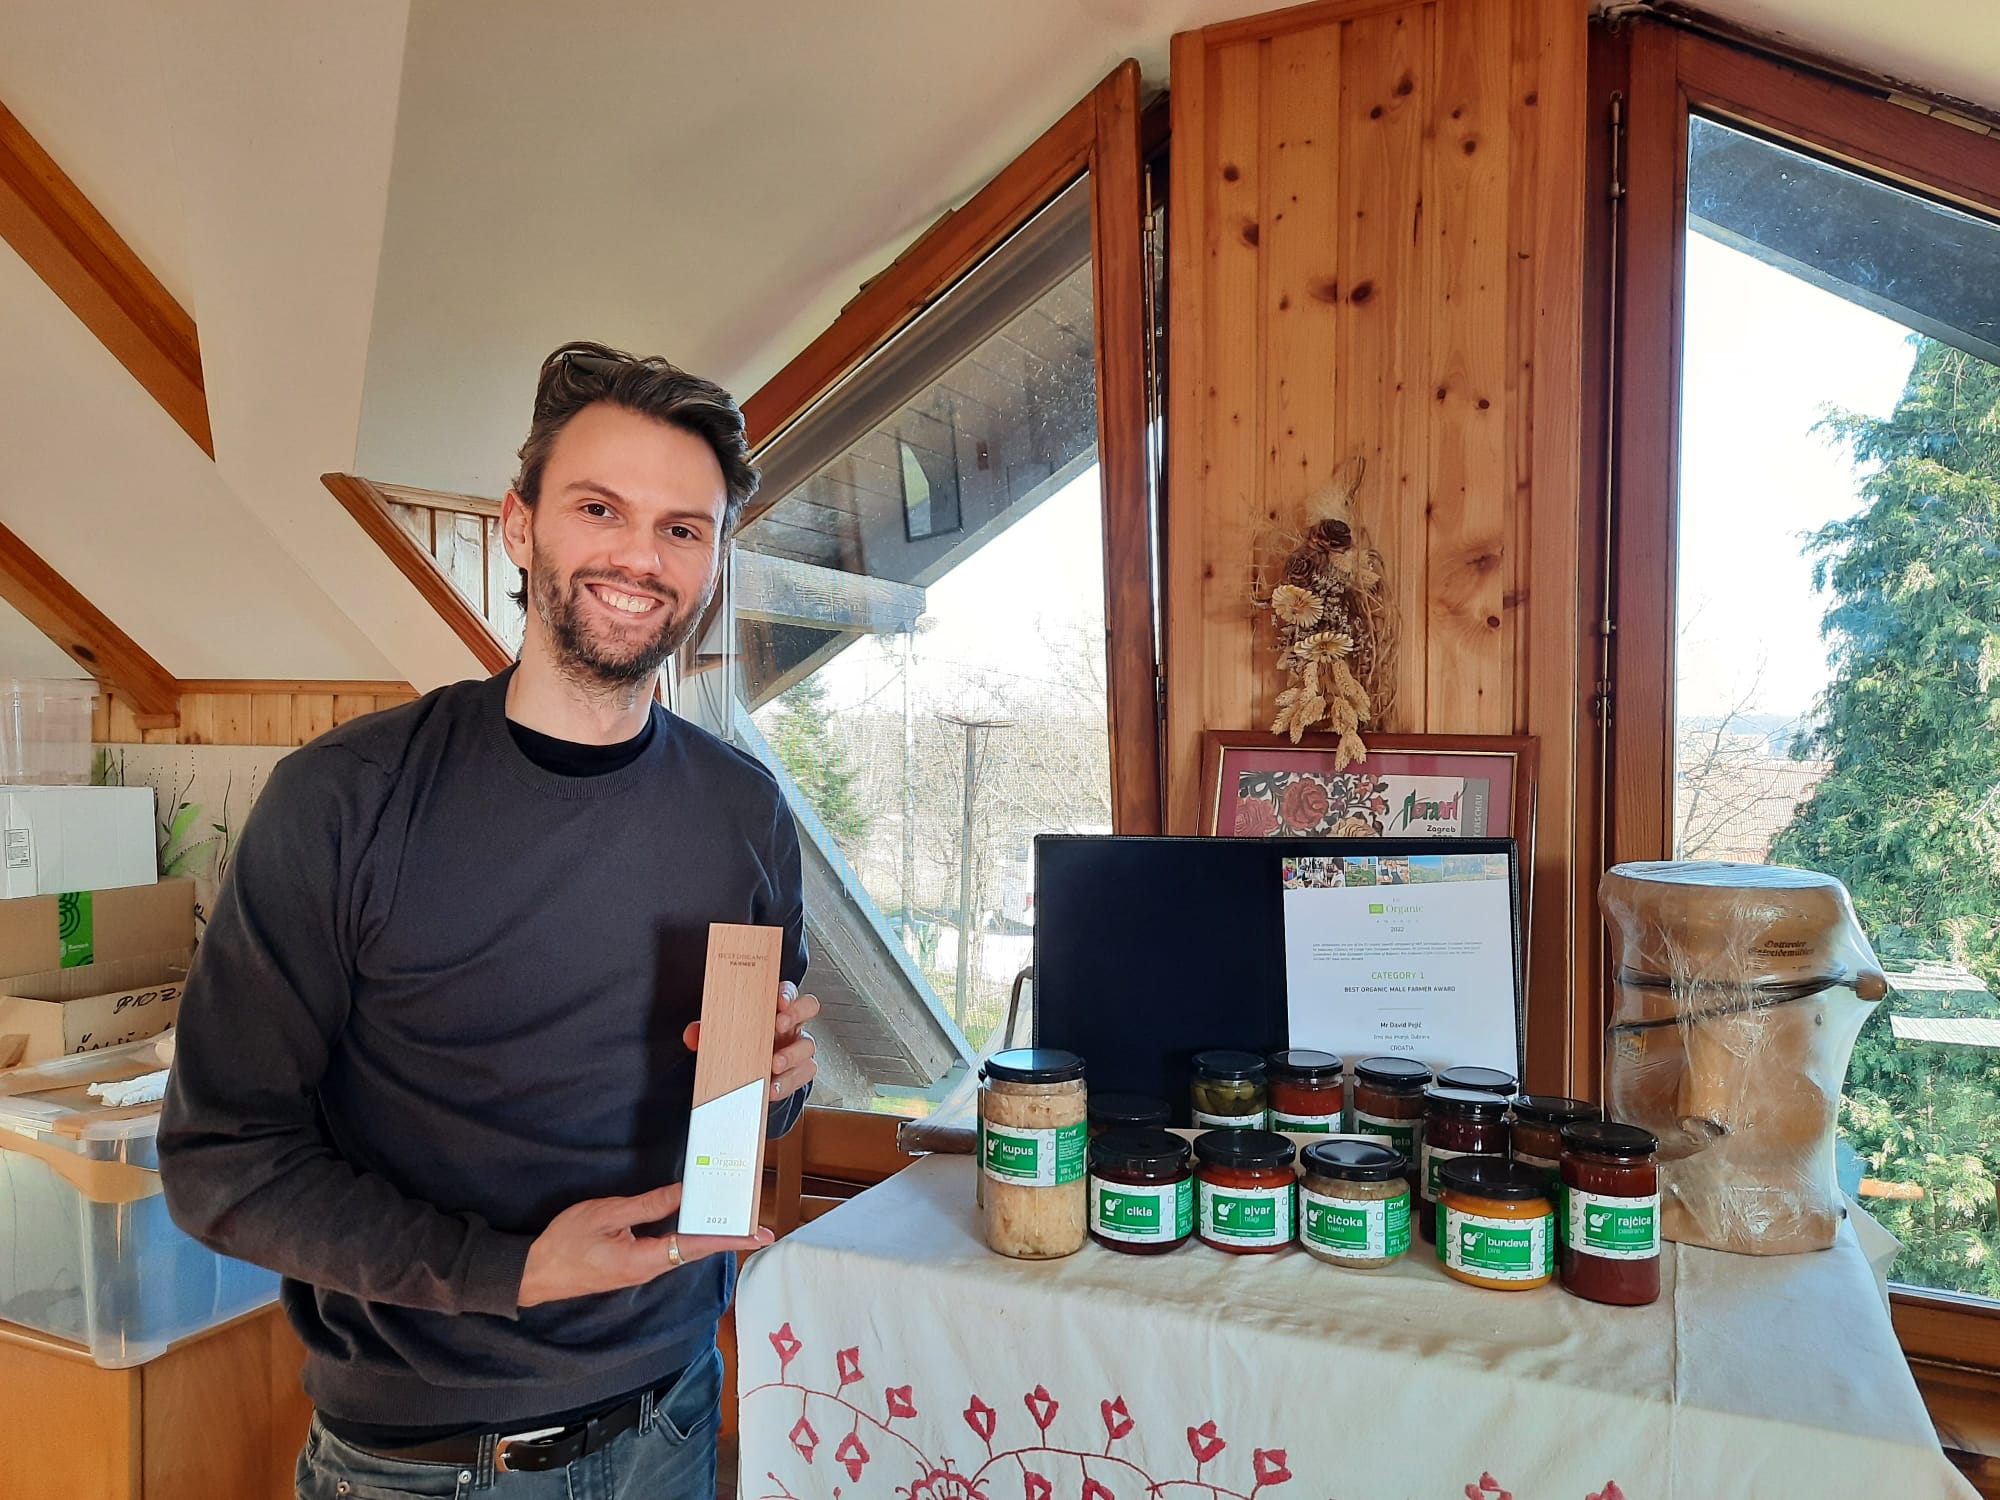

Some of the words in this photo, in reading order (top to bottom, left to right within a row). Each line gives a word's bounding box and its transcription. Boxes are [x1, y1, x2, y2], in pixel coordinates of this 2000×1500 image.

[1426, 825, 1456, 833] Zagreb
[1371, 971, 1416, 980] CATEGORY
[1420, 971, 1425, 980] 1
[1389, 1021, 1407, 1029] David
[1390, 1044, 1415, 1052] CROATIA
[1002, 1142, 1034, 1157] kupus
[712, 1157, 748, 1168] Organic
[1126, 1206, 1153, 1218] cikla
[1244, 1205, 1271, 1217] ajvar
[1617, 1216, 1651, 1229] rajčica
[1487, 1236, 1529, 1249] bundeva
